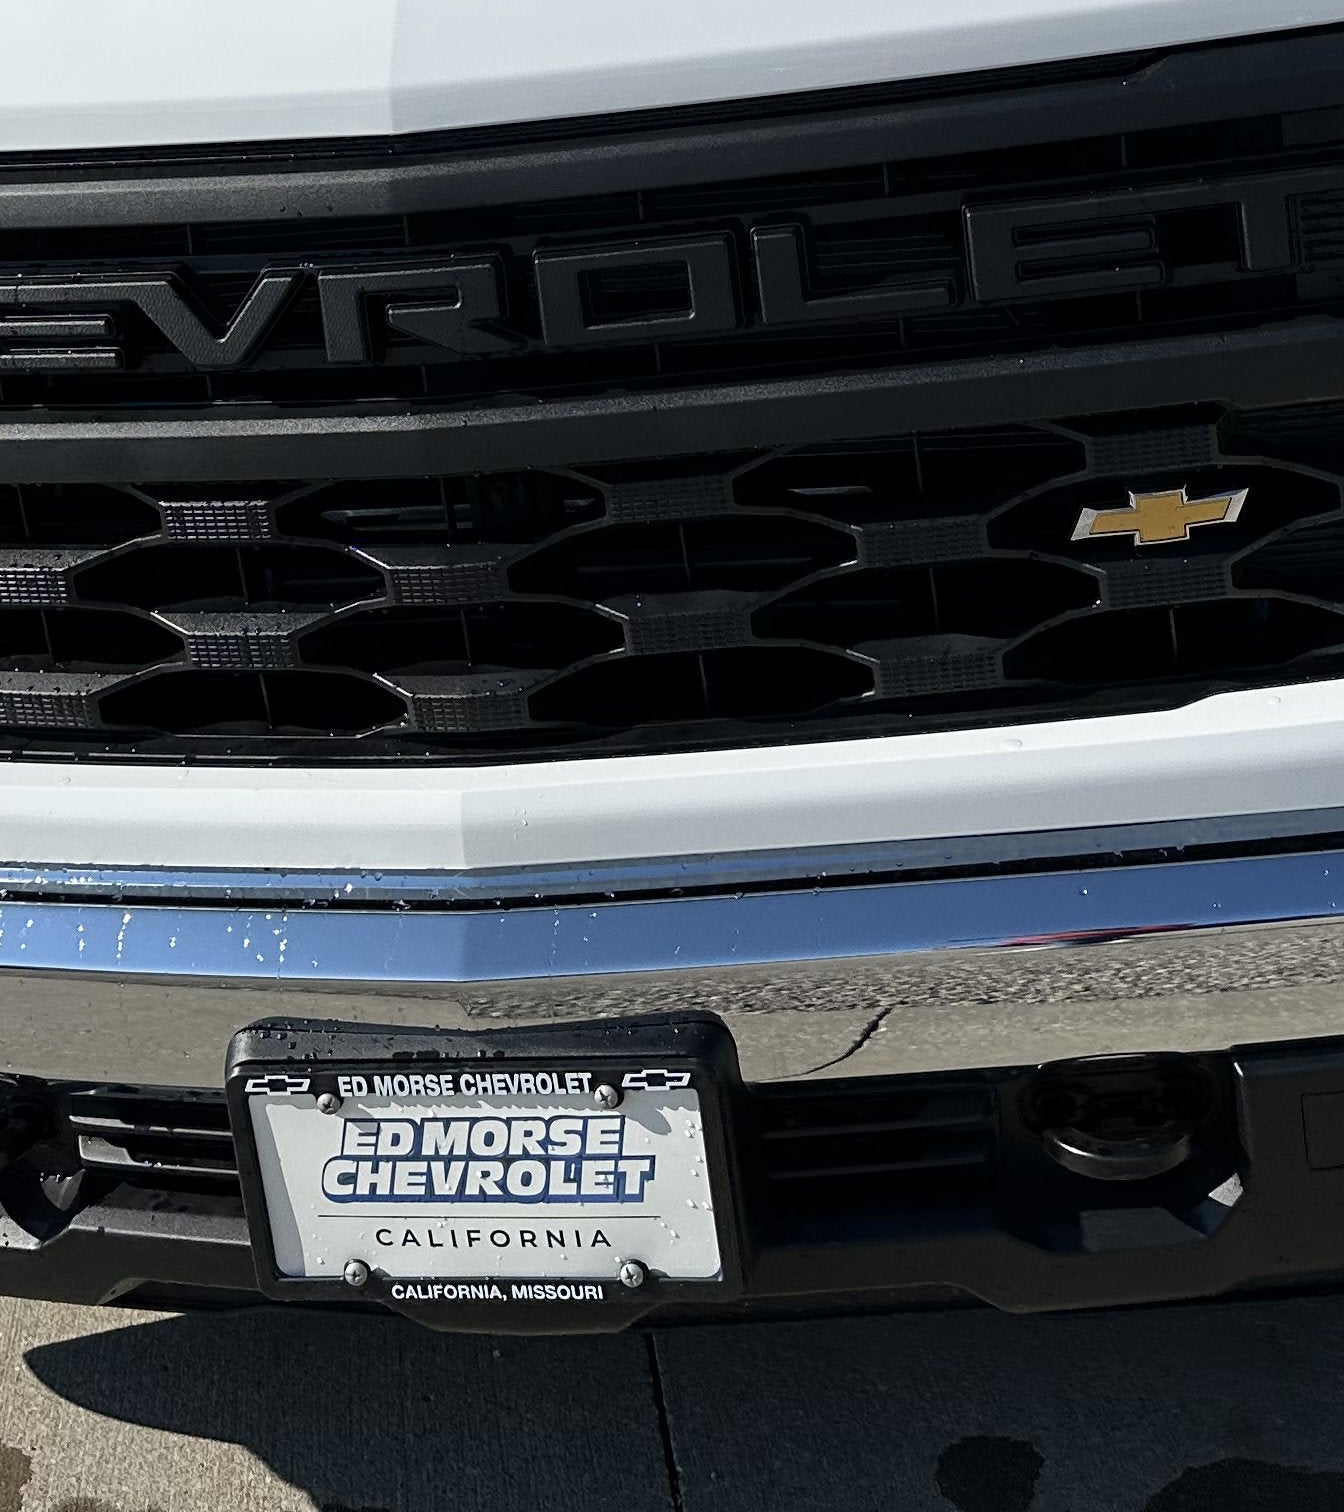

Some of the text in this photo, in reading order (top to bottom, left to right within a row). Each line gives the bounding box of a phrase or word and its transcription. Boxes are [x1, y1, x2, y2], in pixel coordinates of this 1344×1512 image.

[337, 1072, 592, 1097] ED MORSE CHEVROLET
[342, 1116, 624, 1156] ED MORSE
[323, 1158, 652, 1197] CHEVROLET
[375, 1228, 612, 1249] CALIFORNIA
[391, 1284, 604, 1302] CALIFORNIA, MISSOURI
